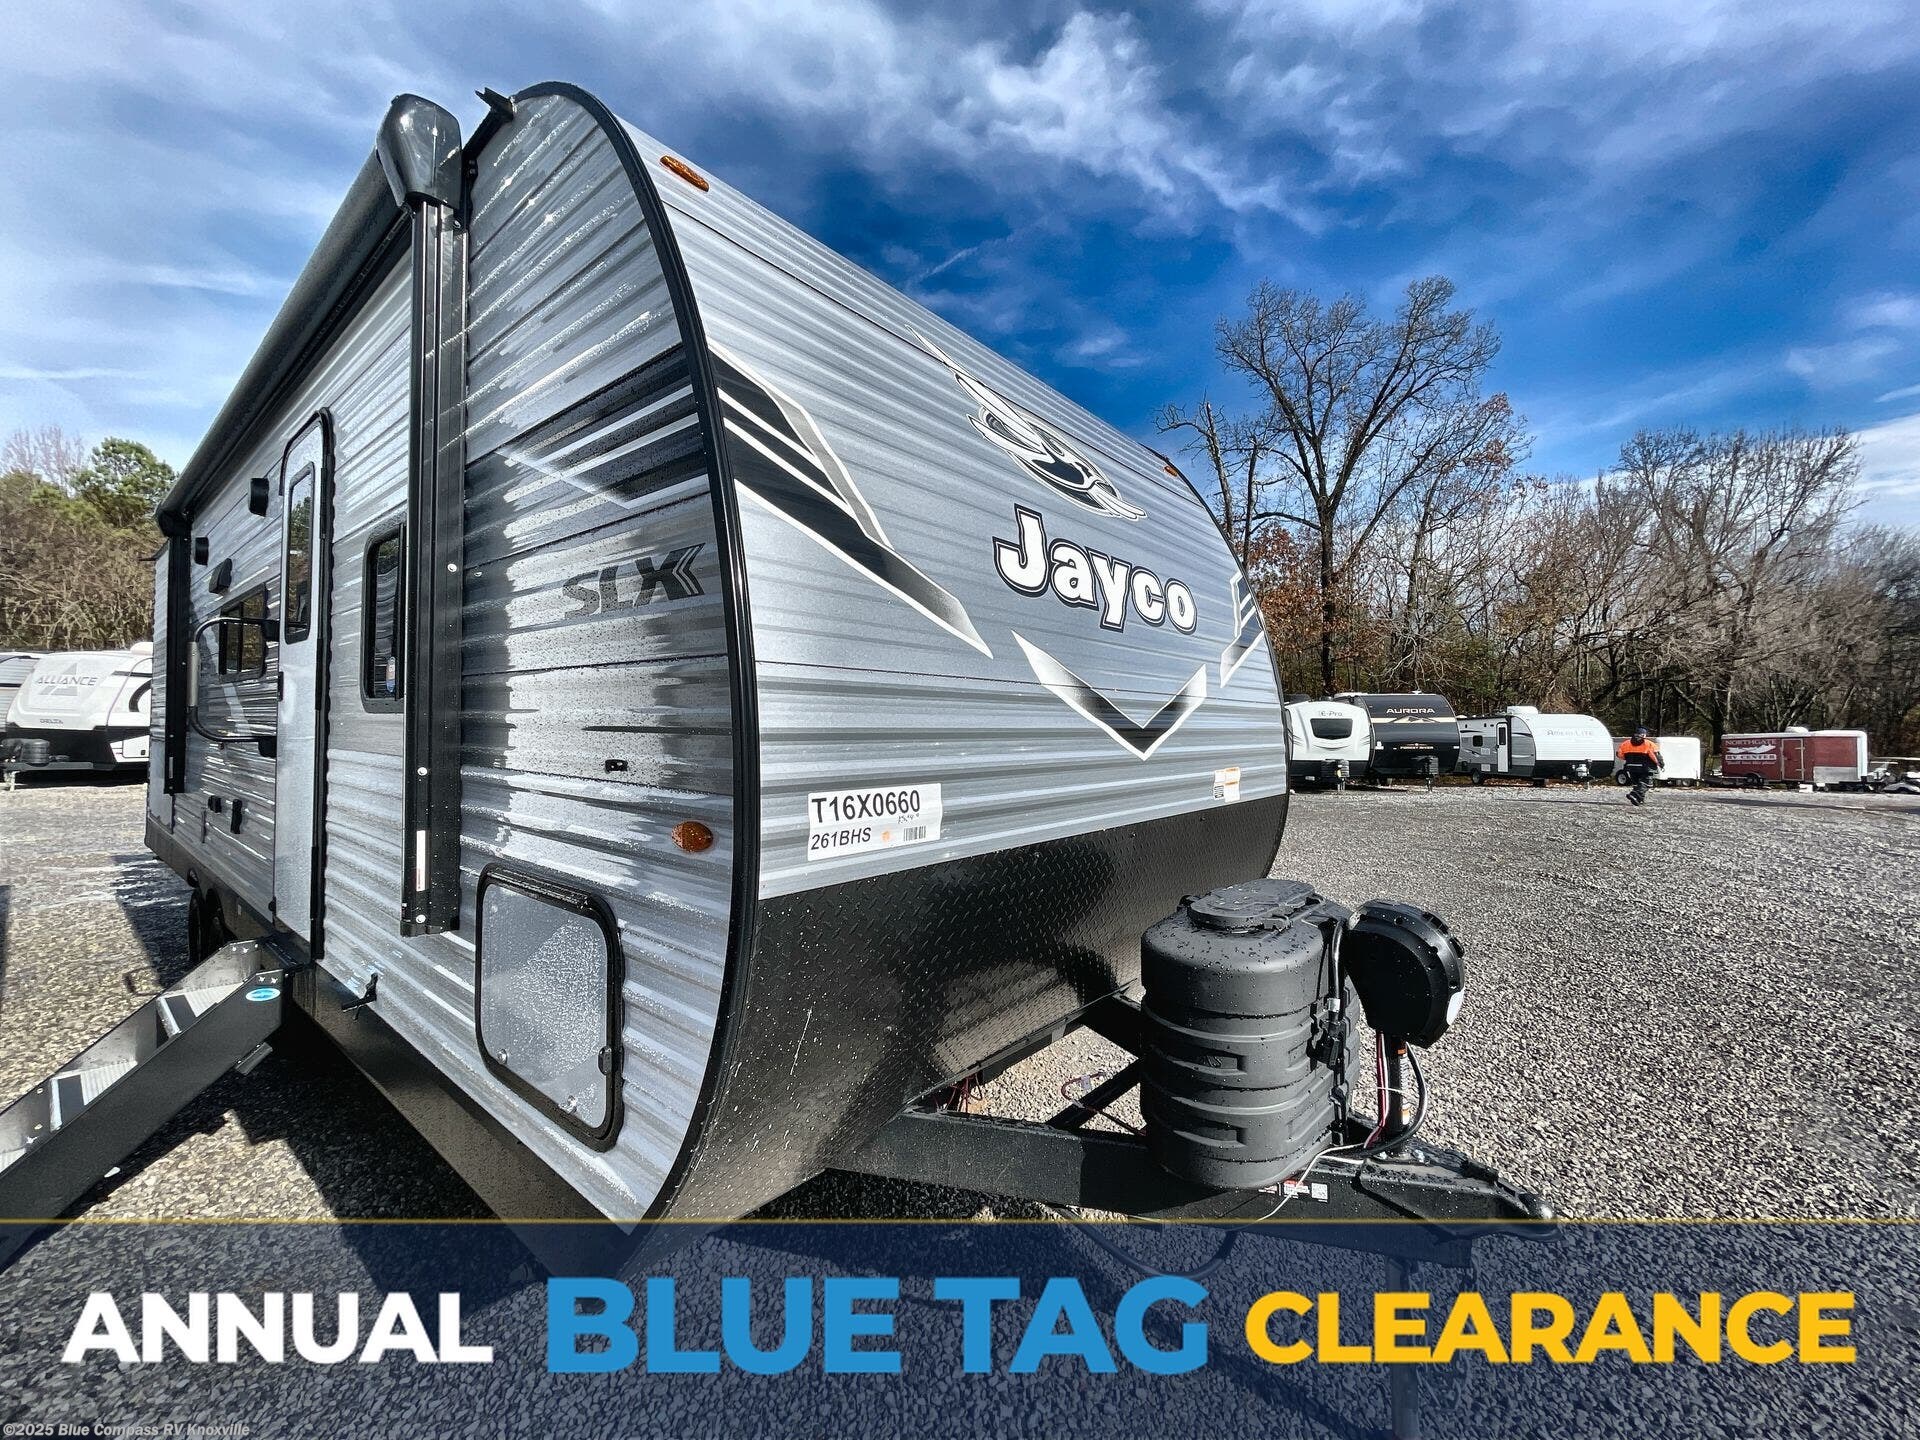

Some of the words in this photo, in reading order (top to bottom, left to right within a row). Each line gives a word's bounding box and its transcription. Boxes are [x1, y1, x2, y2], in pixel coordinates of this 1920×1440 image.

[562, 542, 706, 620] SLX
[992, 503, 1198, 634] Jayco
[36, 675, 98, 687] ALLIANCE
[1386, 707, 1436, 715] AURORA
[811, 789, 920, 823] T16X0660
[811, 826, 872, 850] 261BHS
